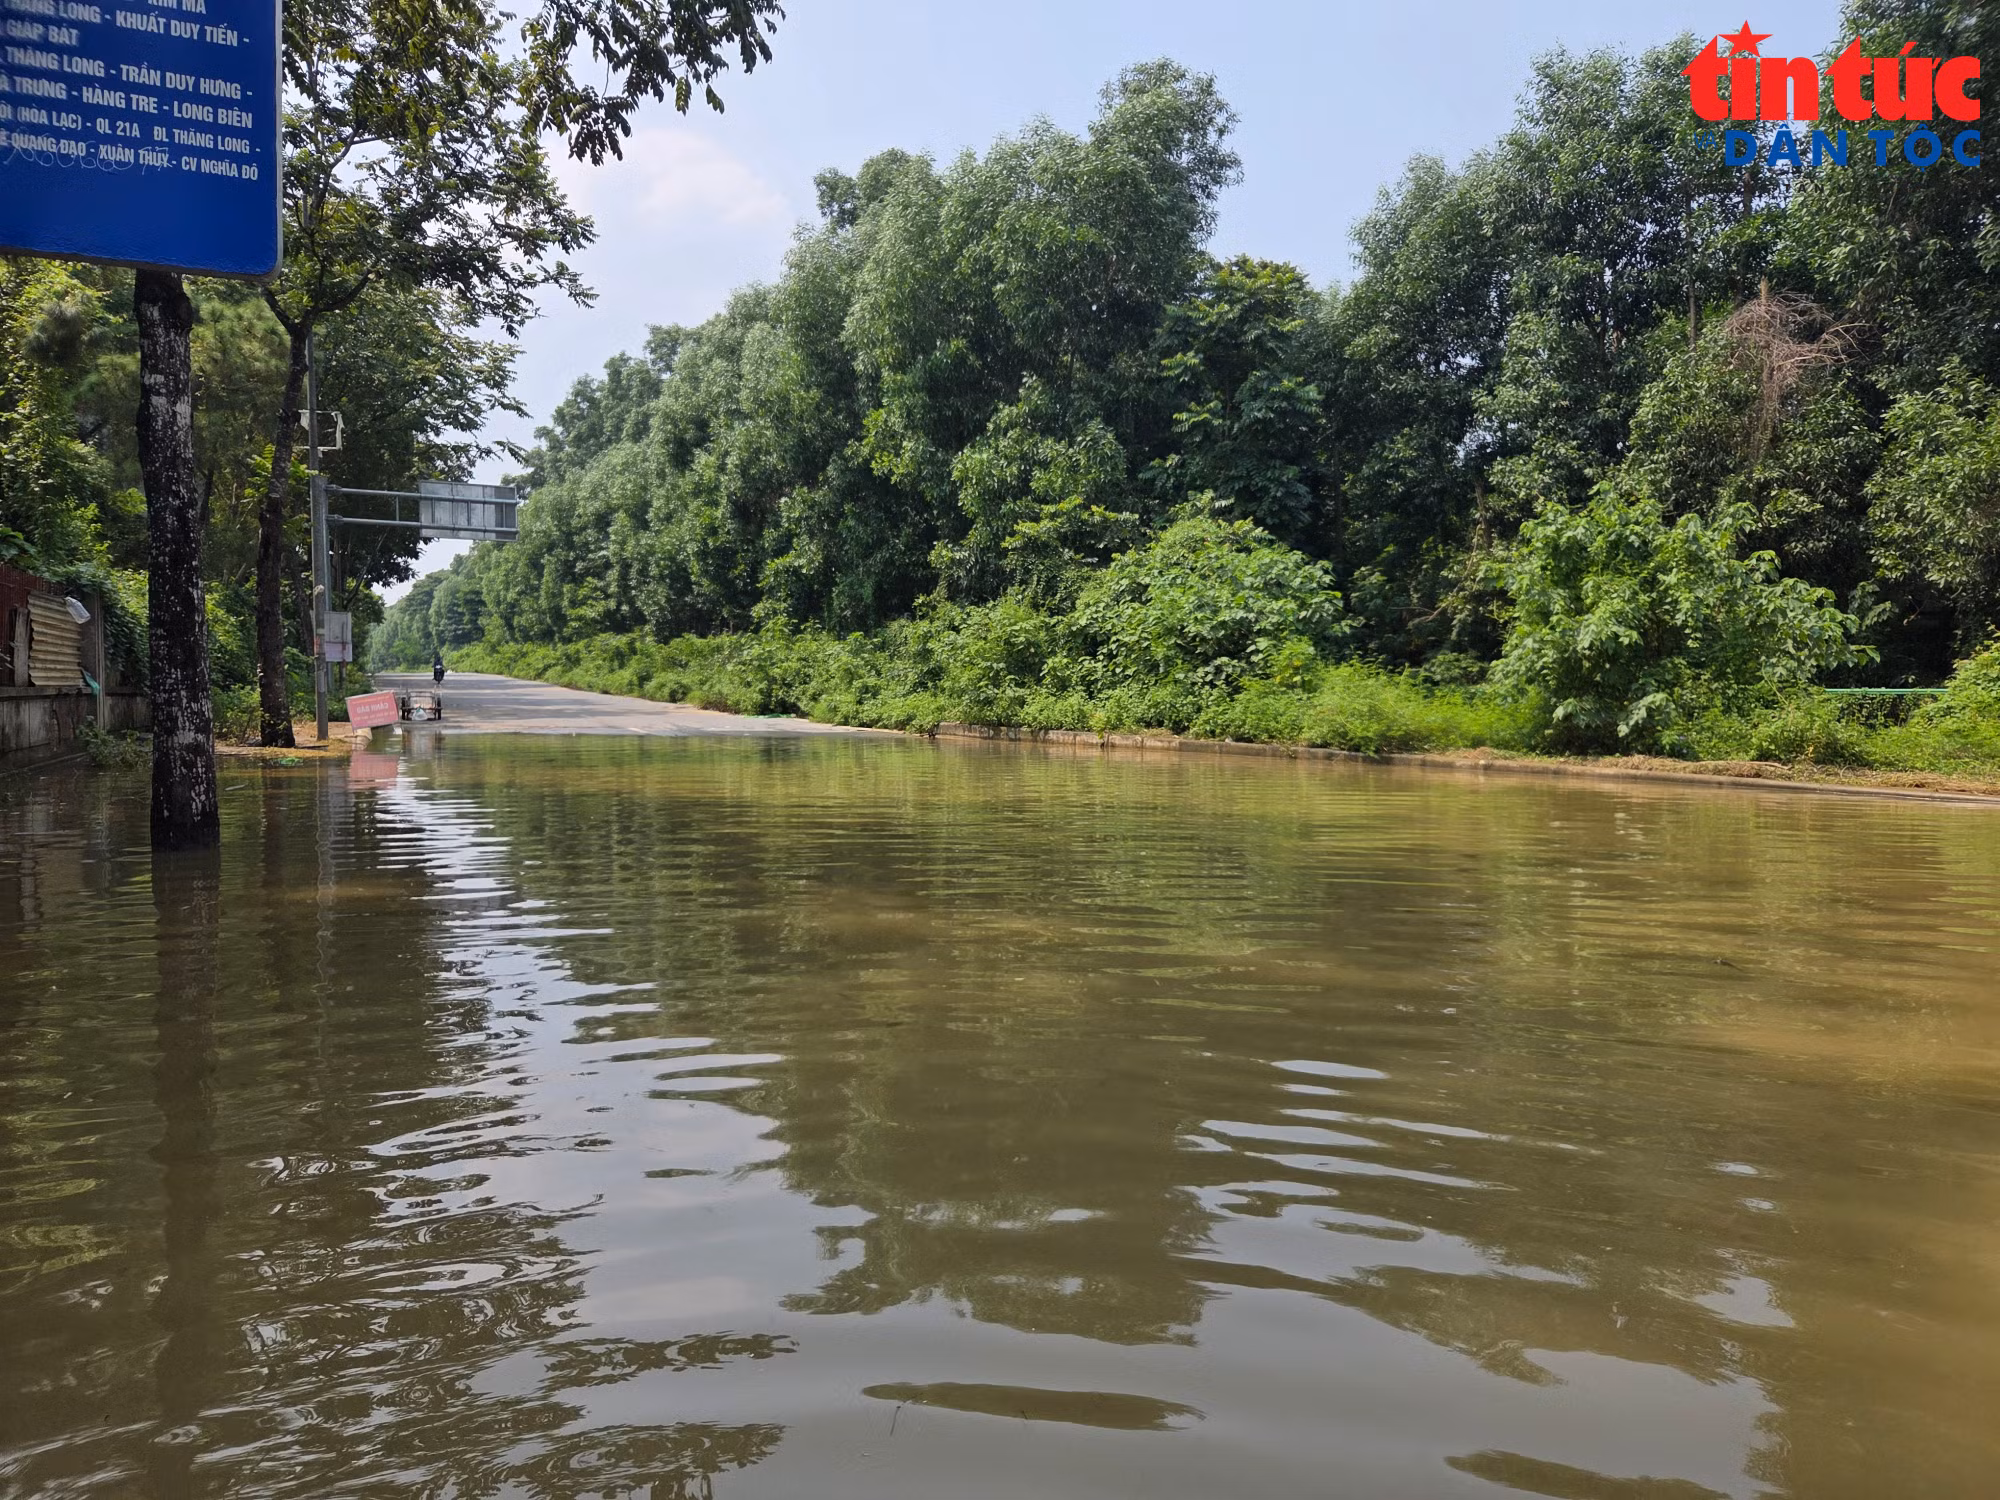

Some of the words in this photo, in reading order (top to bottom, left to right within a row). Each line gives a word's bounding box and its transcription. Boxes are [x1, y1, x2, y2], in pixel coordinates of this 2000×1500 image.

[58, 1, 102, 23] LONG
[115, 10, 167, 34] KHUẤT
[170, 19, 200, 40] DUY
[204, 22, 238, 47] TIẾN
[63, 54, 105, 78] LONG
[120, 61, 161, 87] TRẦN
[165, 71, 196, 92] DUY
[200, 78, 241, 100] HƯNG
[82, 82, 125, 109] HÀNG
[130, 93, 158, 114] TRE
[173, 101, 213, 122] LONG
[217, 106, 253, 129] BIÊN
[52, 110, 82, 131] LẠC)
[96, 117, 112, 135] QL
[116, 120, 141, 138] 21A
[153, 126, 169, 142] ĐL
[173, 127, 214, 149] THĂNG
[217, 135, 250, 154] LONG
[11, 132, 57, 153] QUANG
[60, 138, 87, 158] ĐẠO
[99, 143, 134, 163] XUÂN
[181, 156, 198, 172] CV
[200, 159, 239, 178] NGHĨA
[241, 163, 259, 181] ĐÔ
